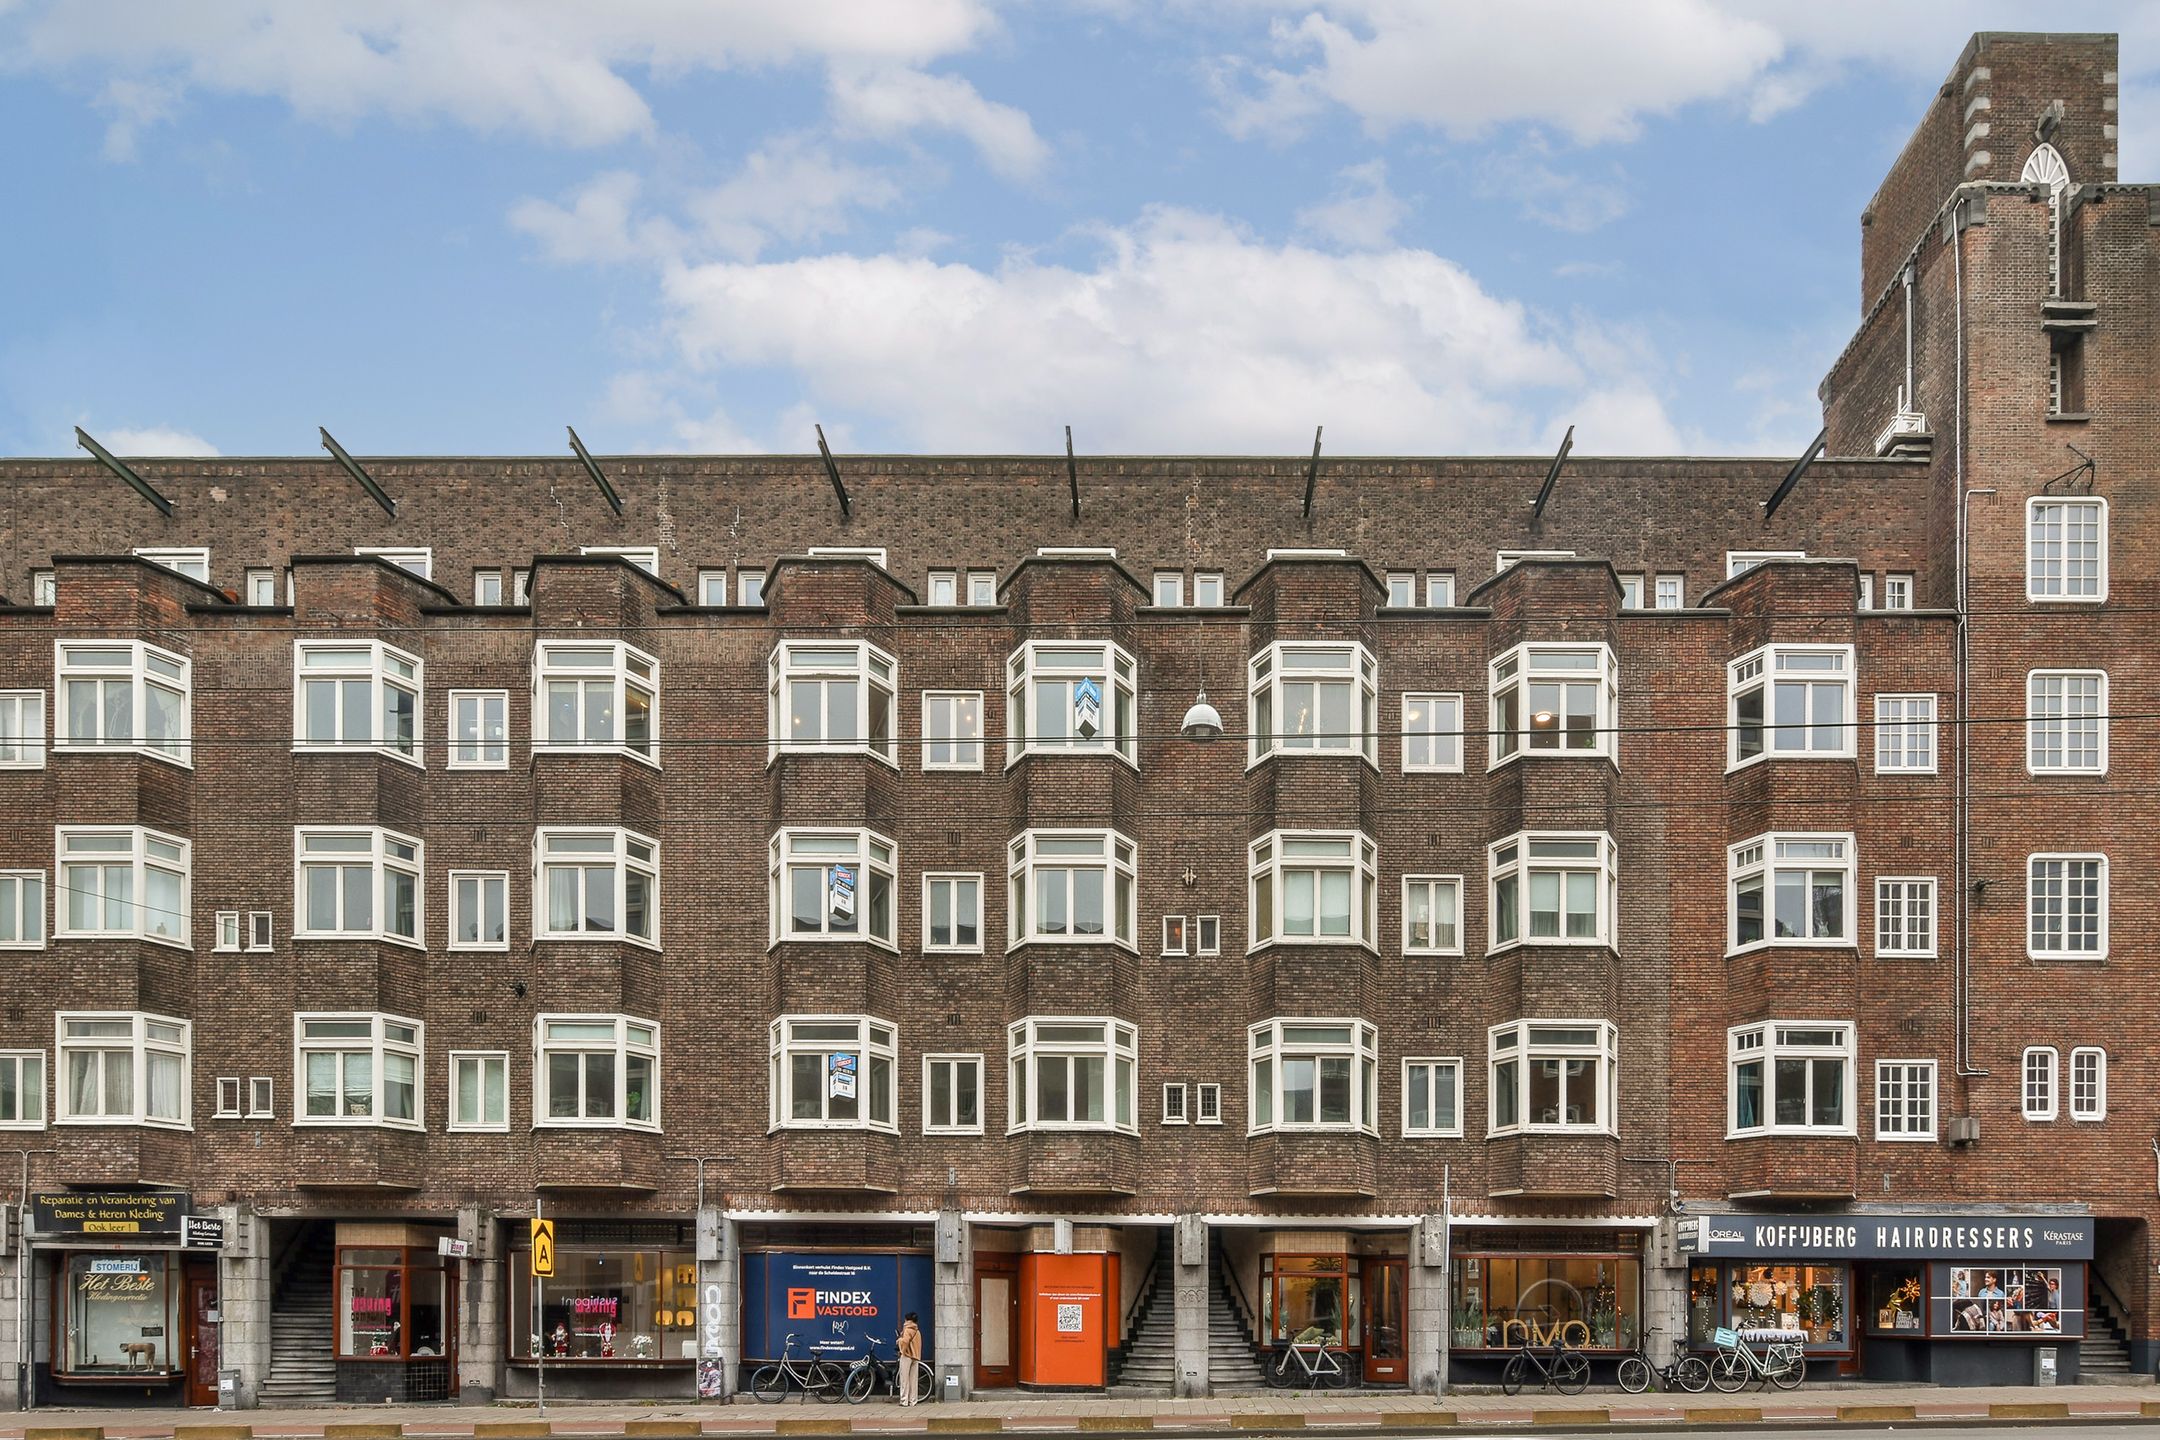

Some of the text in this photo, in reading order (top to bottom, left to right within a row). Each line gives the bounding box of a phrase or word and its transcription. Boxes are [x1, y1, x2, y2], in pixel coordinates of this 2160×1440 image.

[40, 1195, 176, 1208] Reparatie en Verandering van
[55, 1209, 165, 1222] Dames & Heren Kleding
[88, 1223, 107, 1232] Ook
[109, 1223, 126, 1232] leer
[188, 1220, 222, 1231] Het Beste
[1755, 1225, 2034, 1249] KOFFIJBERG HAIRDRESSERS
[2043, 1230, 2084, 1241] KÉRASTASE
[539, 1244, 550, 1265] A
[96, 1263, 138, 1271] STOMERIJ
[79, 1274, 156, 1291] Het Beste
[816, 1291, 872, 1304] FINDEX
[816, 1306, 878, 1316] VASTGOED
